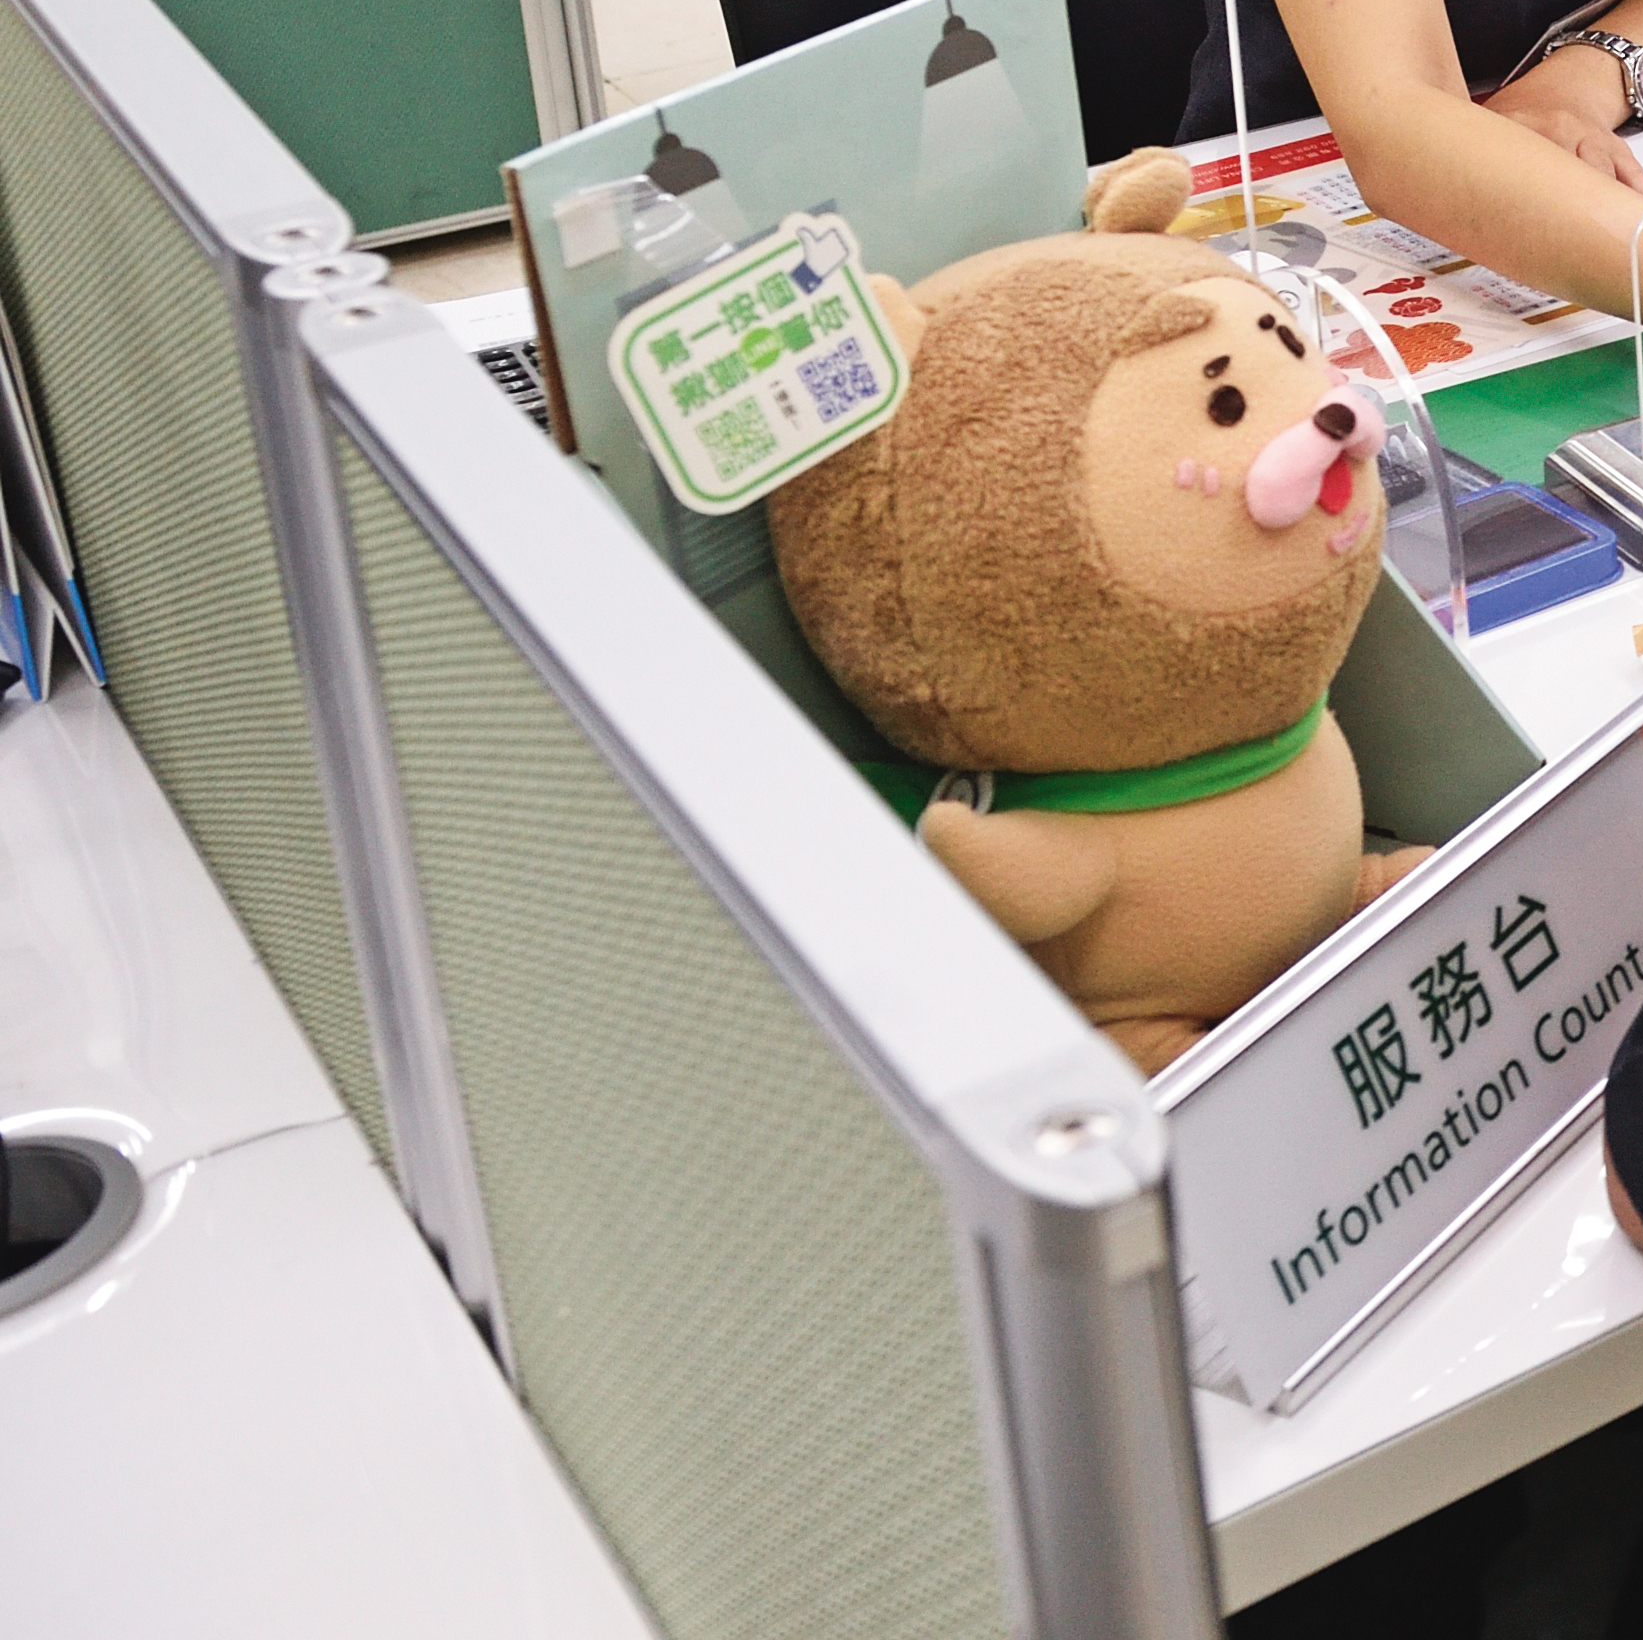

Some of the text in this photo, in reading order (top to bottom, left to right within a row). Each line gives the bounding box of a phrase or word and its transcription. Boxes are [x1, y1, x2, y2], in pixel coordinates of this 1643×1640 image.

[1331, 892, 1562, 1130] 服務台
[1271, 1060, 1529, 1306] Information
